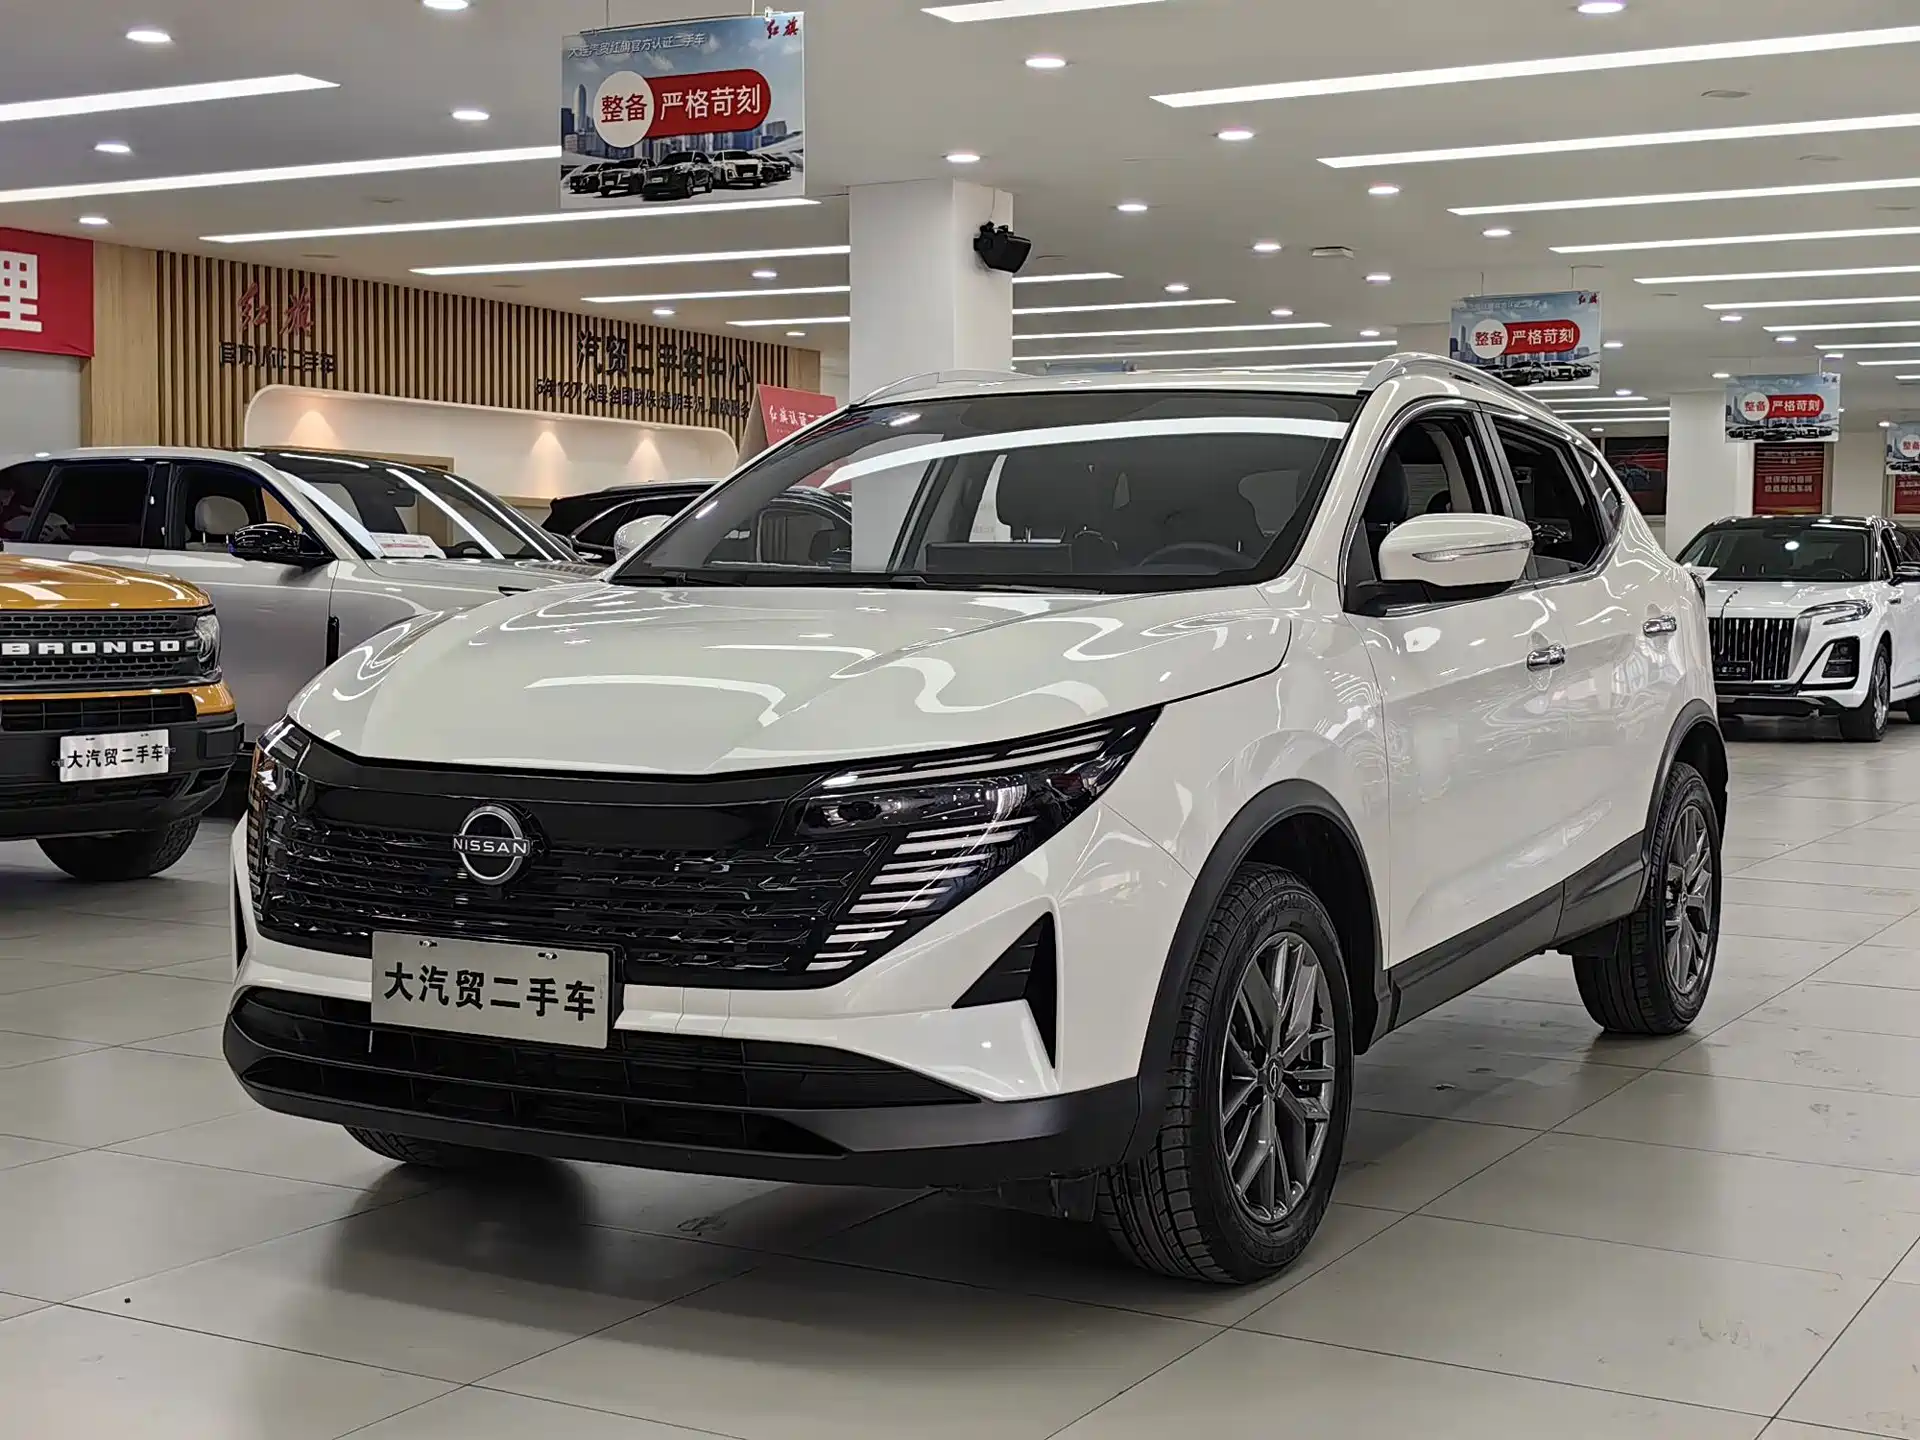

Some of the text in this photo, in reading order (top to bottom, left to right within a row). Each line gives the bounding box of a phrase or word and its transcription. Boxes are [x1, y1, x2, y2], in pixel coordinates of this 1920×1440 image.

[600, 93, 648, 123] 整备
[659, 83, 761, 121] 严格苛刻
[1474, 330, 1505, 347] 整备
[1511, 327, 1574, 346] 严格苛刻
[1771, 398, 1821, 413] 严格苛刻
[1, 639, 181, 656] BRONCO
[66, 743, 165, 770] 大汽贸二手车
[452, 837, 529, 855] NISSAN
[384, 961, 597, 1022] 大汽贸二手车
